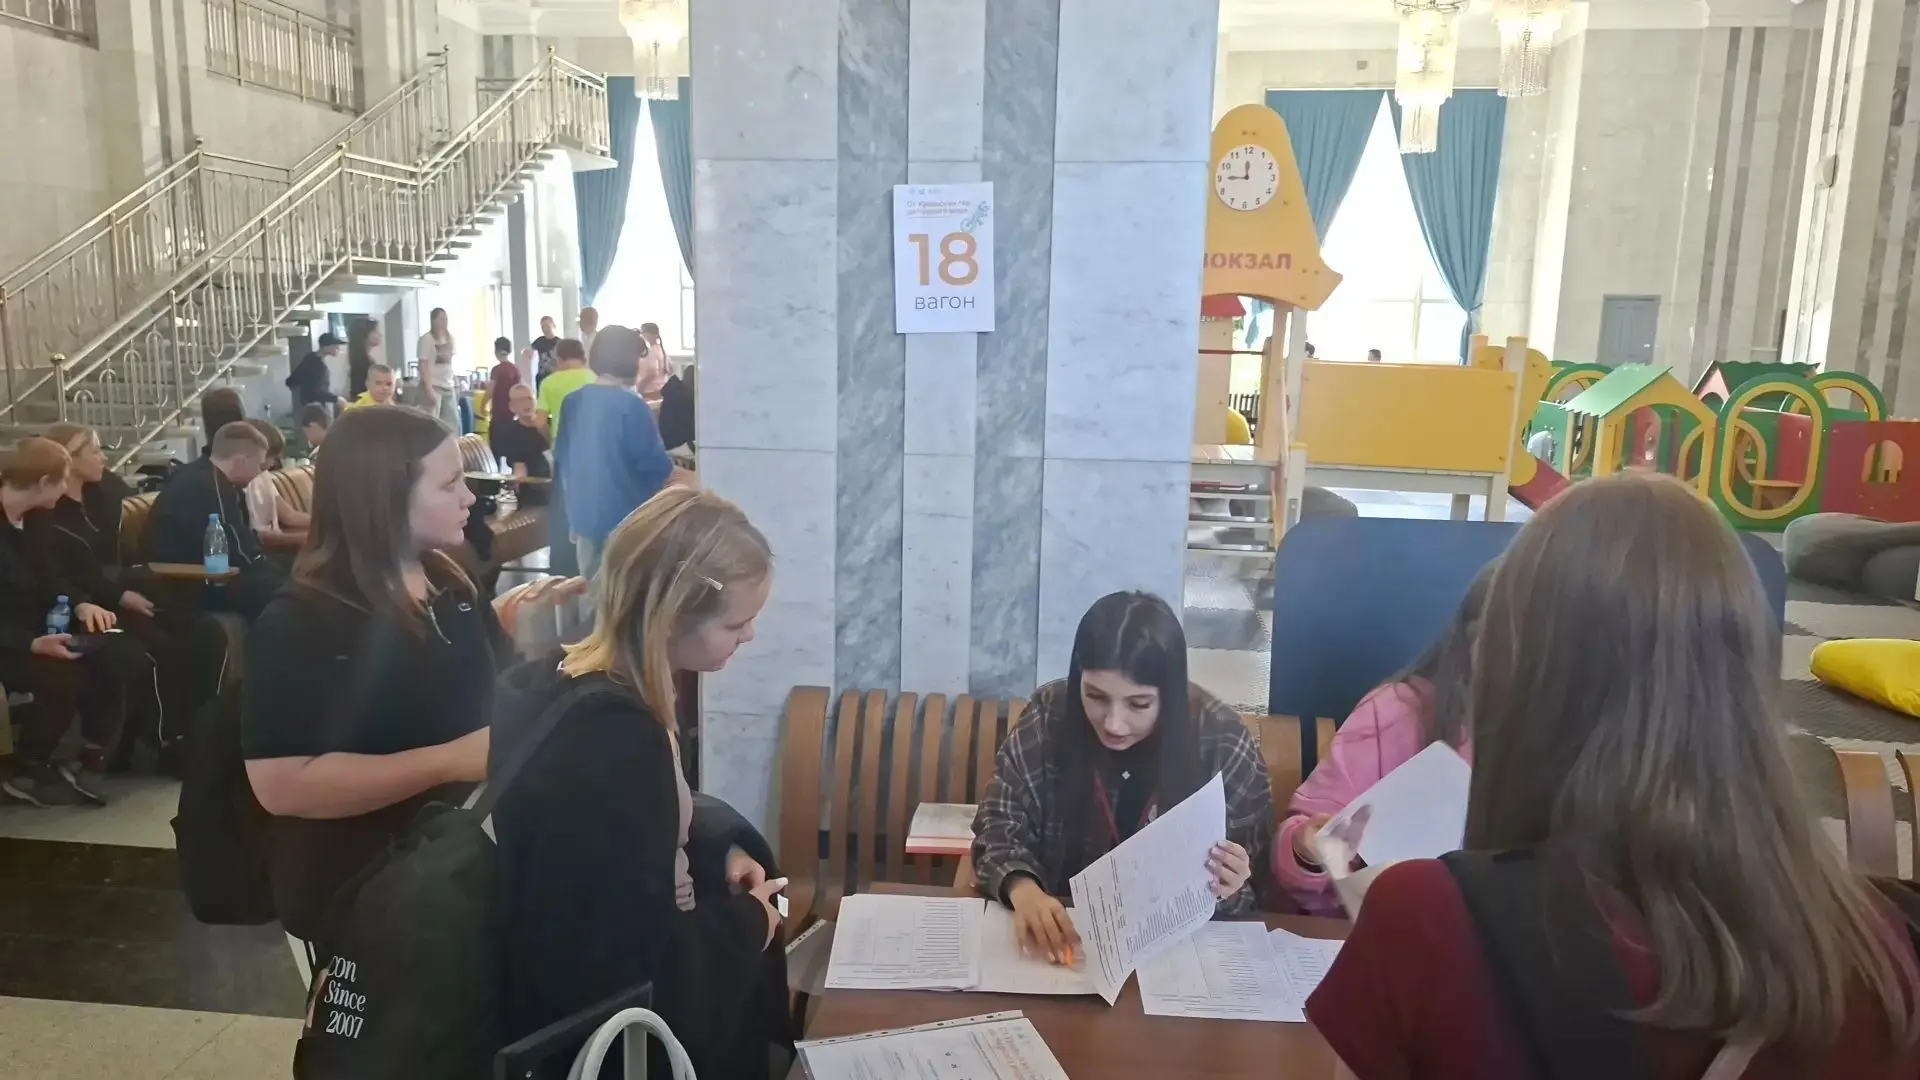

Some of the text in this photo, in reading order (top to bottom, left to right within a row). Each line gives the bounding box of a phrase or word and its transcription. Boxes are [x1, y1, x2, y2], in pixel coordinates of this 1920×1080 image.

[1245, 147, 1254, 155] 12
[1222, 162, 1231, 170] 10
[908, 231, 979, 286] 18
[915, 296, 975, 310] вагон
[324, 980, 367, 1012] Since
[325, 1010, 364, 1039] 2007
